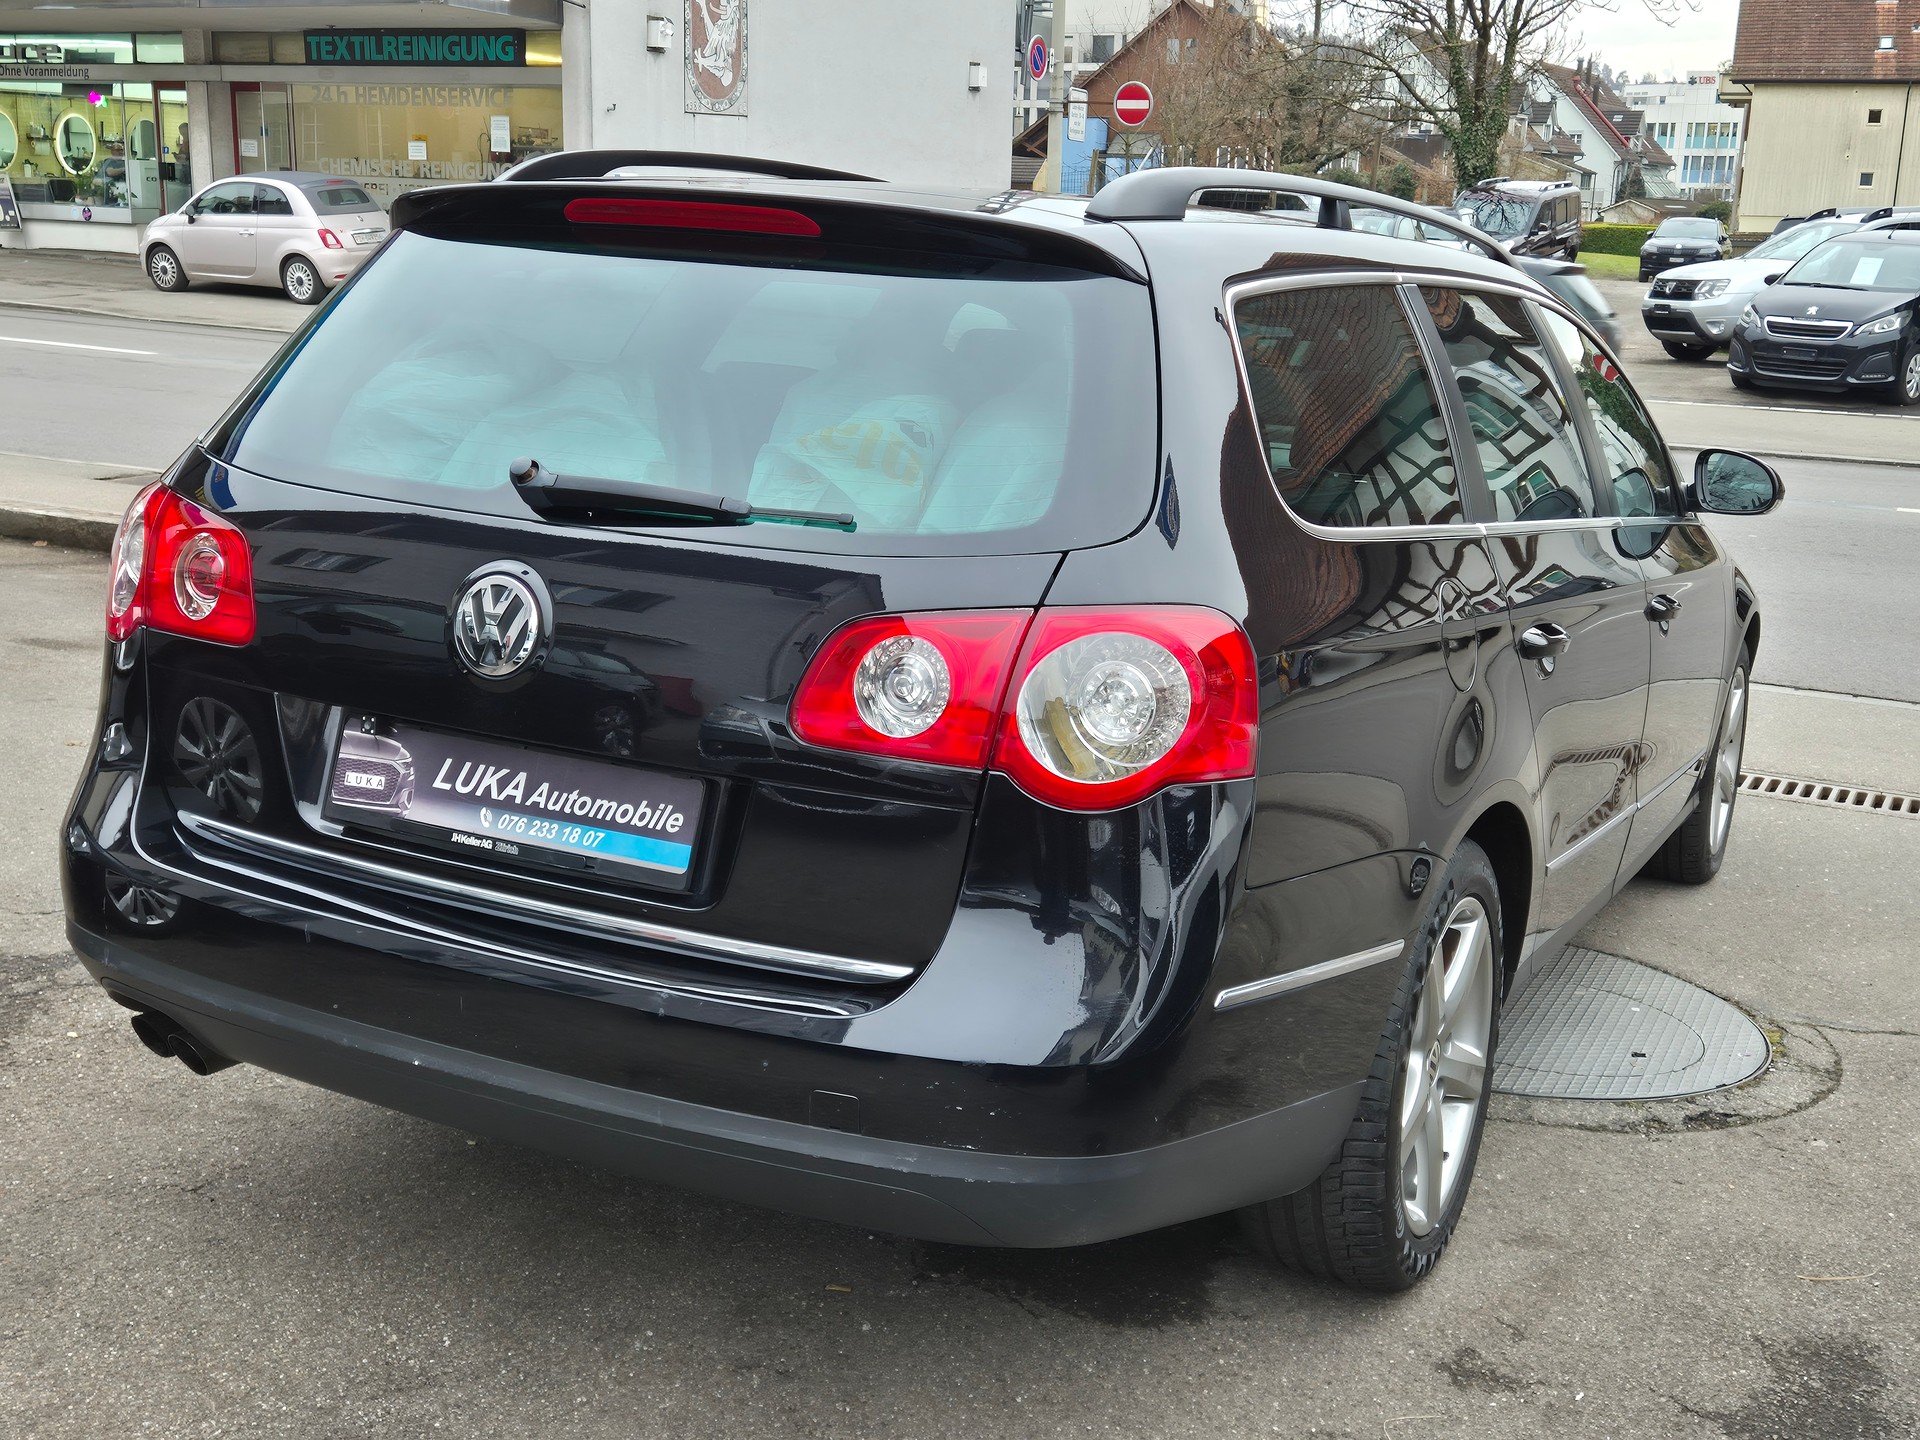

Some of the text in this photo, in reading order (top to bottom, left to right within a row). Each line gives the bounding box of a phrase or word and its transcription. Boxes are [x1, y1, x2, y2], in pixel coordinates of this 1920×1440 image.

[307, 35, 515, 61] TEXTILREINIGUNG
[0, 64, 89, 80] Ohne Voranmeldung
[1699, 76, 1716, 84] UBS
[311, 85, 513, 108] 24 h HEMDENSERVICE
[318, 157, 414, 178] CHEMISCHE
[345, 774, 383, 788] LUKA
[432, 758, 684, 834] LUKA Automobile
[497, 813, 606, 848] 076 233 18 07
